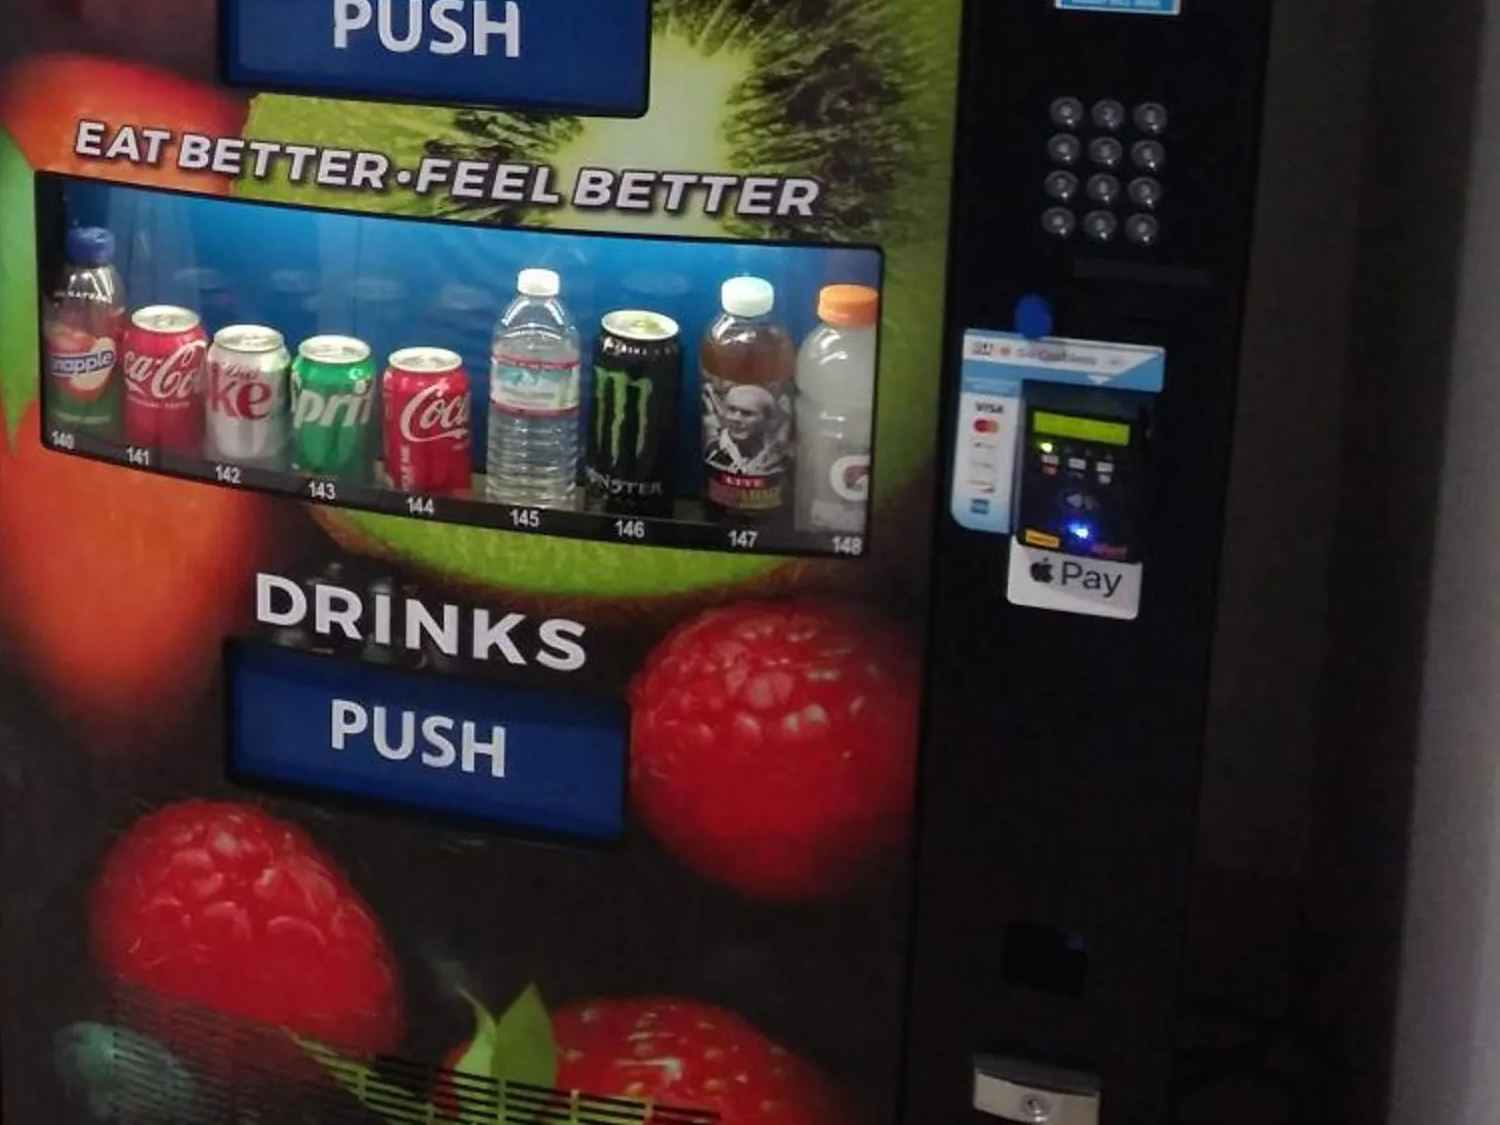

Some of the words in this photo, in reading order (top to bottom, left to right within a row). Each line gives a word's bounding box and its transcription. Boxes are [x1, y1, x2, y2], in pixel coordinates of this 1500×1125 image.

[74, 121, 171, 165] EAT
[177, 134, 390, 189] BETTER
[414, 157, 560, 205] FEEL
[573, 168, 820, 217] BETTER
[51, 431, 75, 450] 140
[126, 446, 150, 466] 141
[215, 465, 242, 484] 142
[308, 481, 337, 501] 143
[406, 497, 435, 516] 144
[510, 509, 540, 528] 145
[615, 519, 645, 539] 146
[728, 530, 758, 548] 147
[832, 535, 862, 555] 148
[1060, 561, 1123, 598] Pay
[255, 572, 587, 672] DRINKS
[331, 697, 507, 778] PUSH
